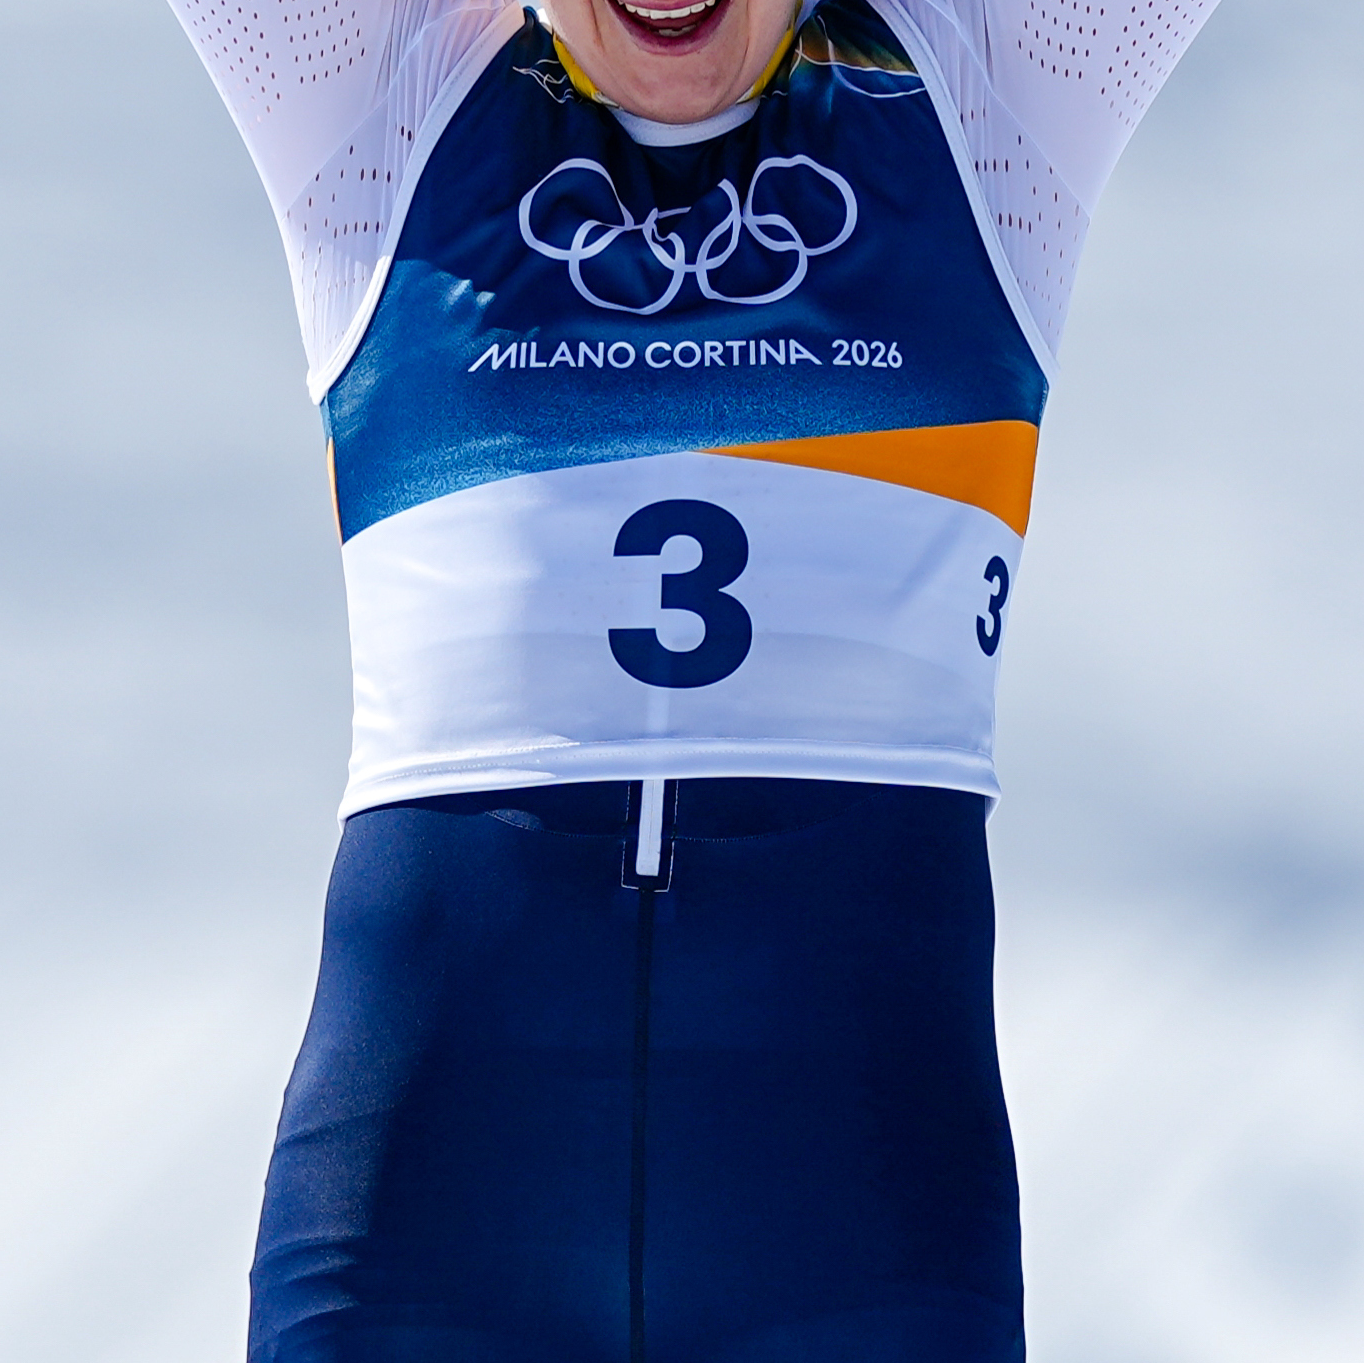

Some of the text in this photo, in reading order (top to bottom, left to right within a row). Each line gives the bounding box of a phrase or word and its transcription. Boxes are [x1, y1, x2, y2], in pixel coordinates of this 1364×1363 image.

[467, 339, 903, 372] MILANO CORTINA 2026
[608, 498, 753, 689] 3
[976, 555, 1010, 657] 3
